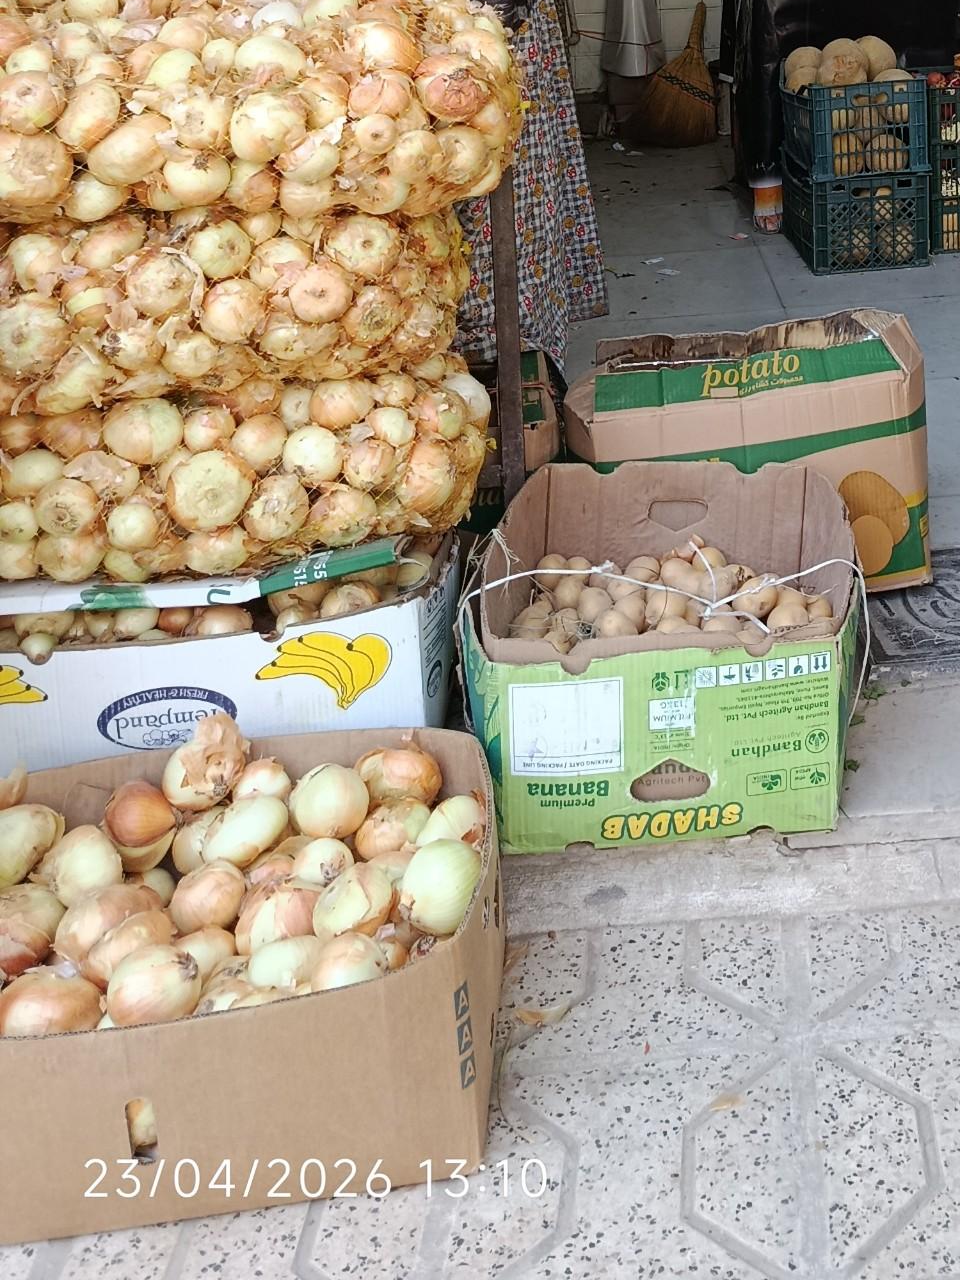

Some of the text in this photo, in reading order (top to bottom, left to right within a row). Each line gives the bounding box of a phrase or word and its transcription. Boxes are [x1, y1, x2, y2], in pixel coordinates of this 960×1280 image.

[699, 351, 801, 397] potato
[179, 688, 209, 700] FRESH
[760, 706, 793, 717] Agritech
[795, 700, 829, 712] Bandhan
[731, 739, 803, 758] Bandhan
[526, 780, 609, 797] Banana
[540, 799, 595, 810] Premium
[600, 801, 743, 841] SHADAB
